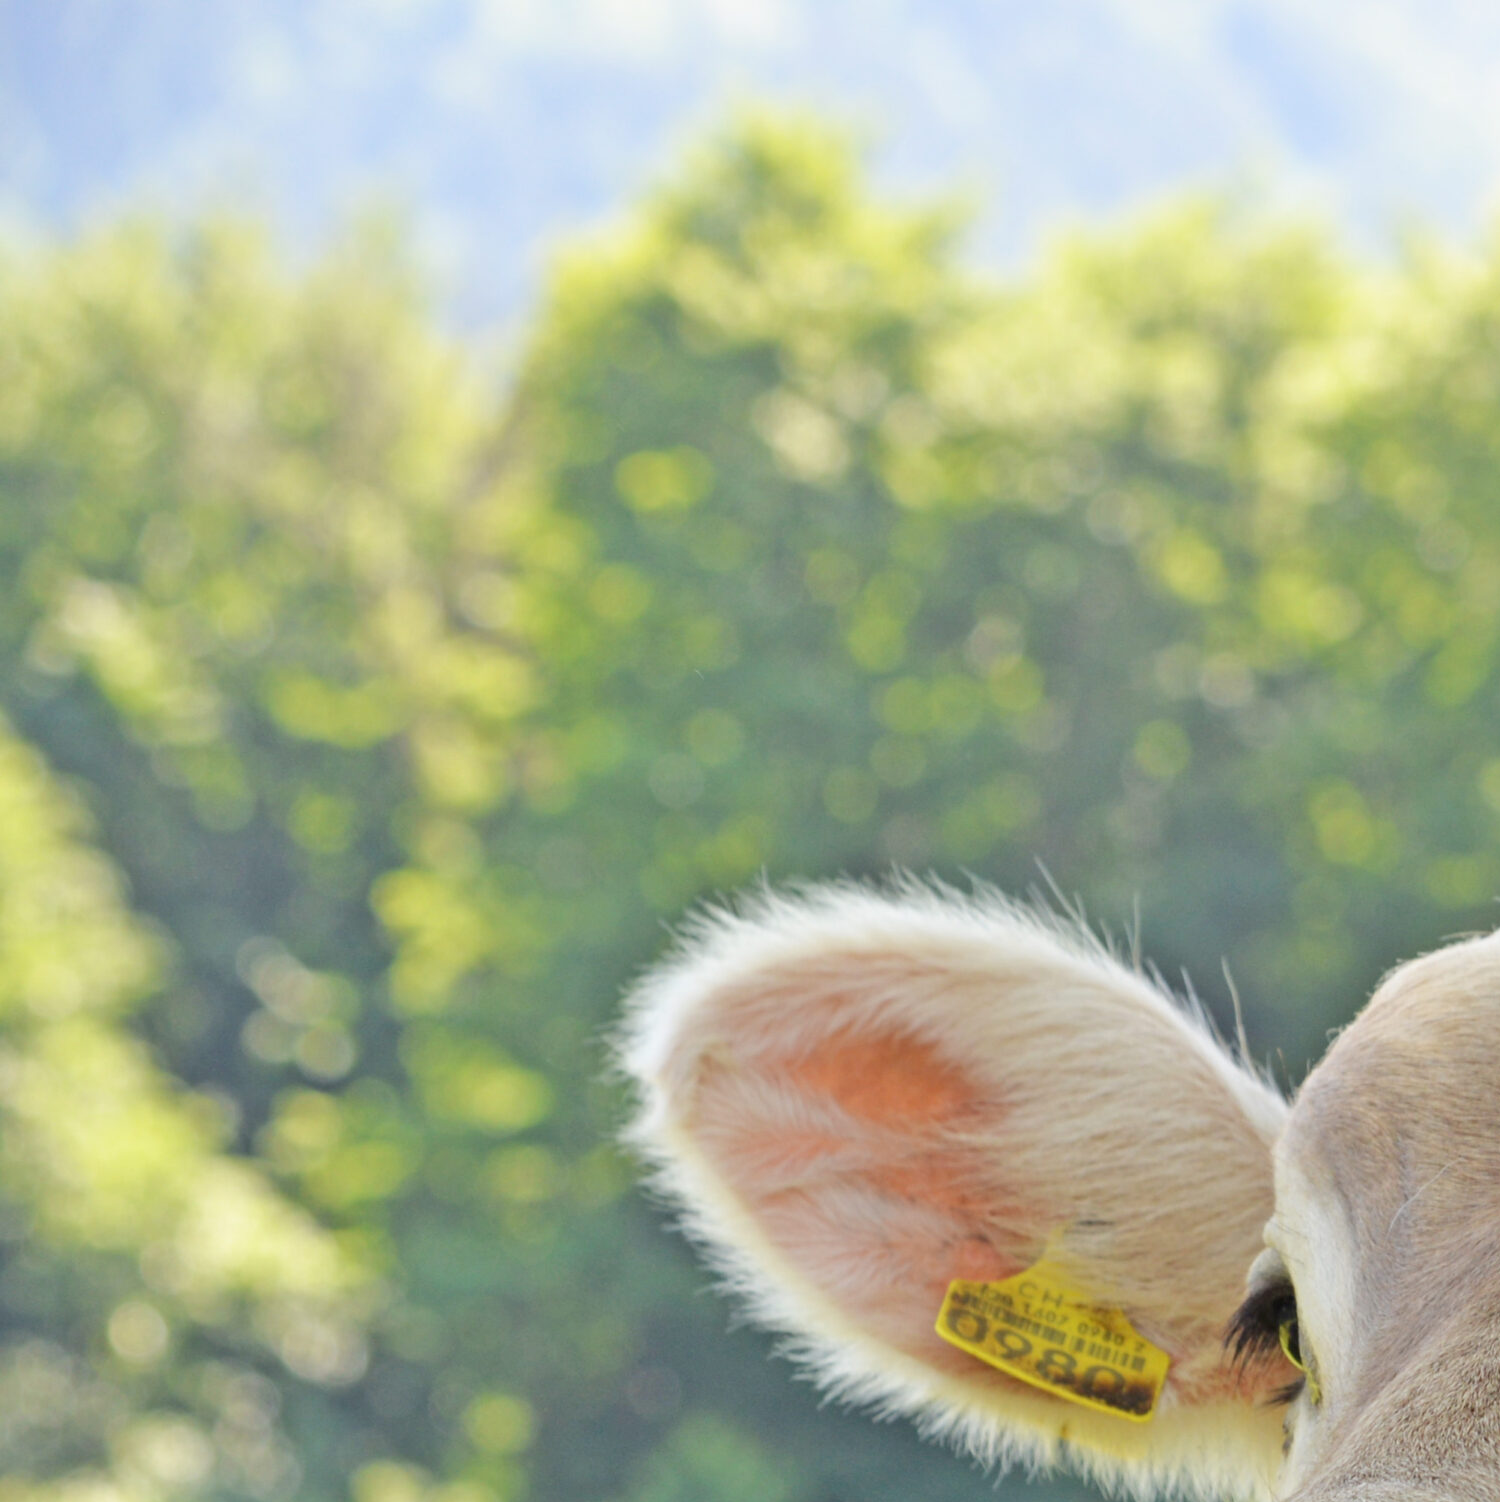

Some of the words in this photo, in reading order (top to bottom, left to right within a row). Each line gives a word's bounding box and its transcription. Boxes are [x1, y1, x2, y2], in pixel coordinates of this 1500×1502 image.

[1018, 1282, 1064, 1308] CH
[1023, 1302, 1069, 1326] 1607
[1077, 1322, 1126, 1347] 0980
[946, 1309, 1127, 1402] 0980
